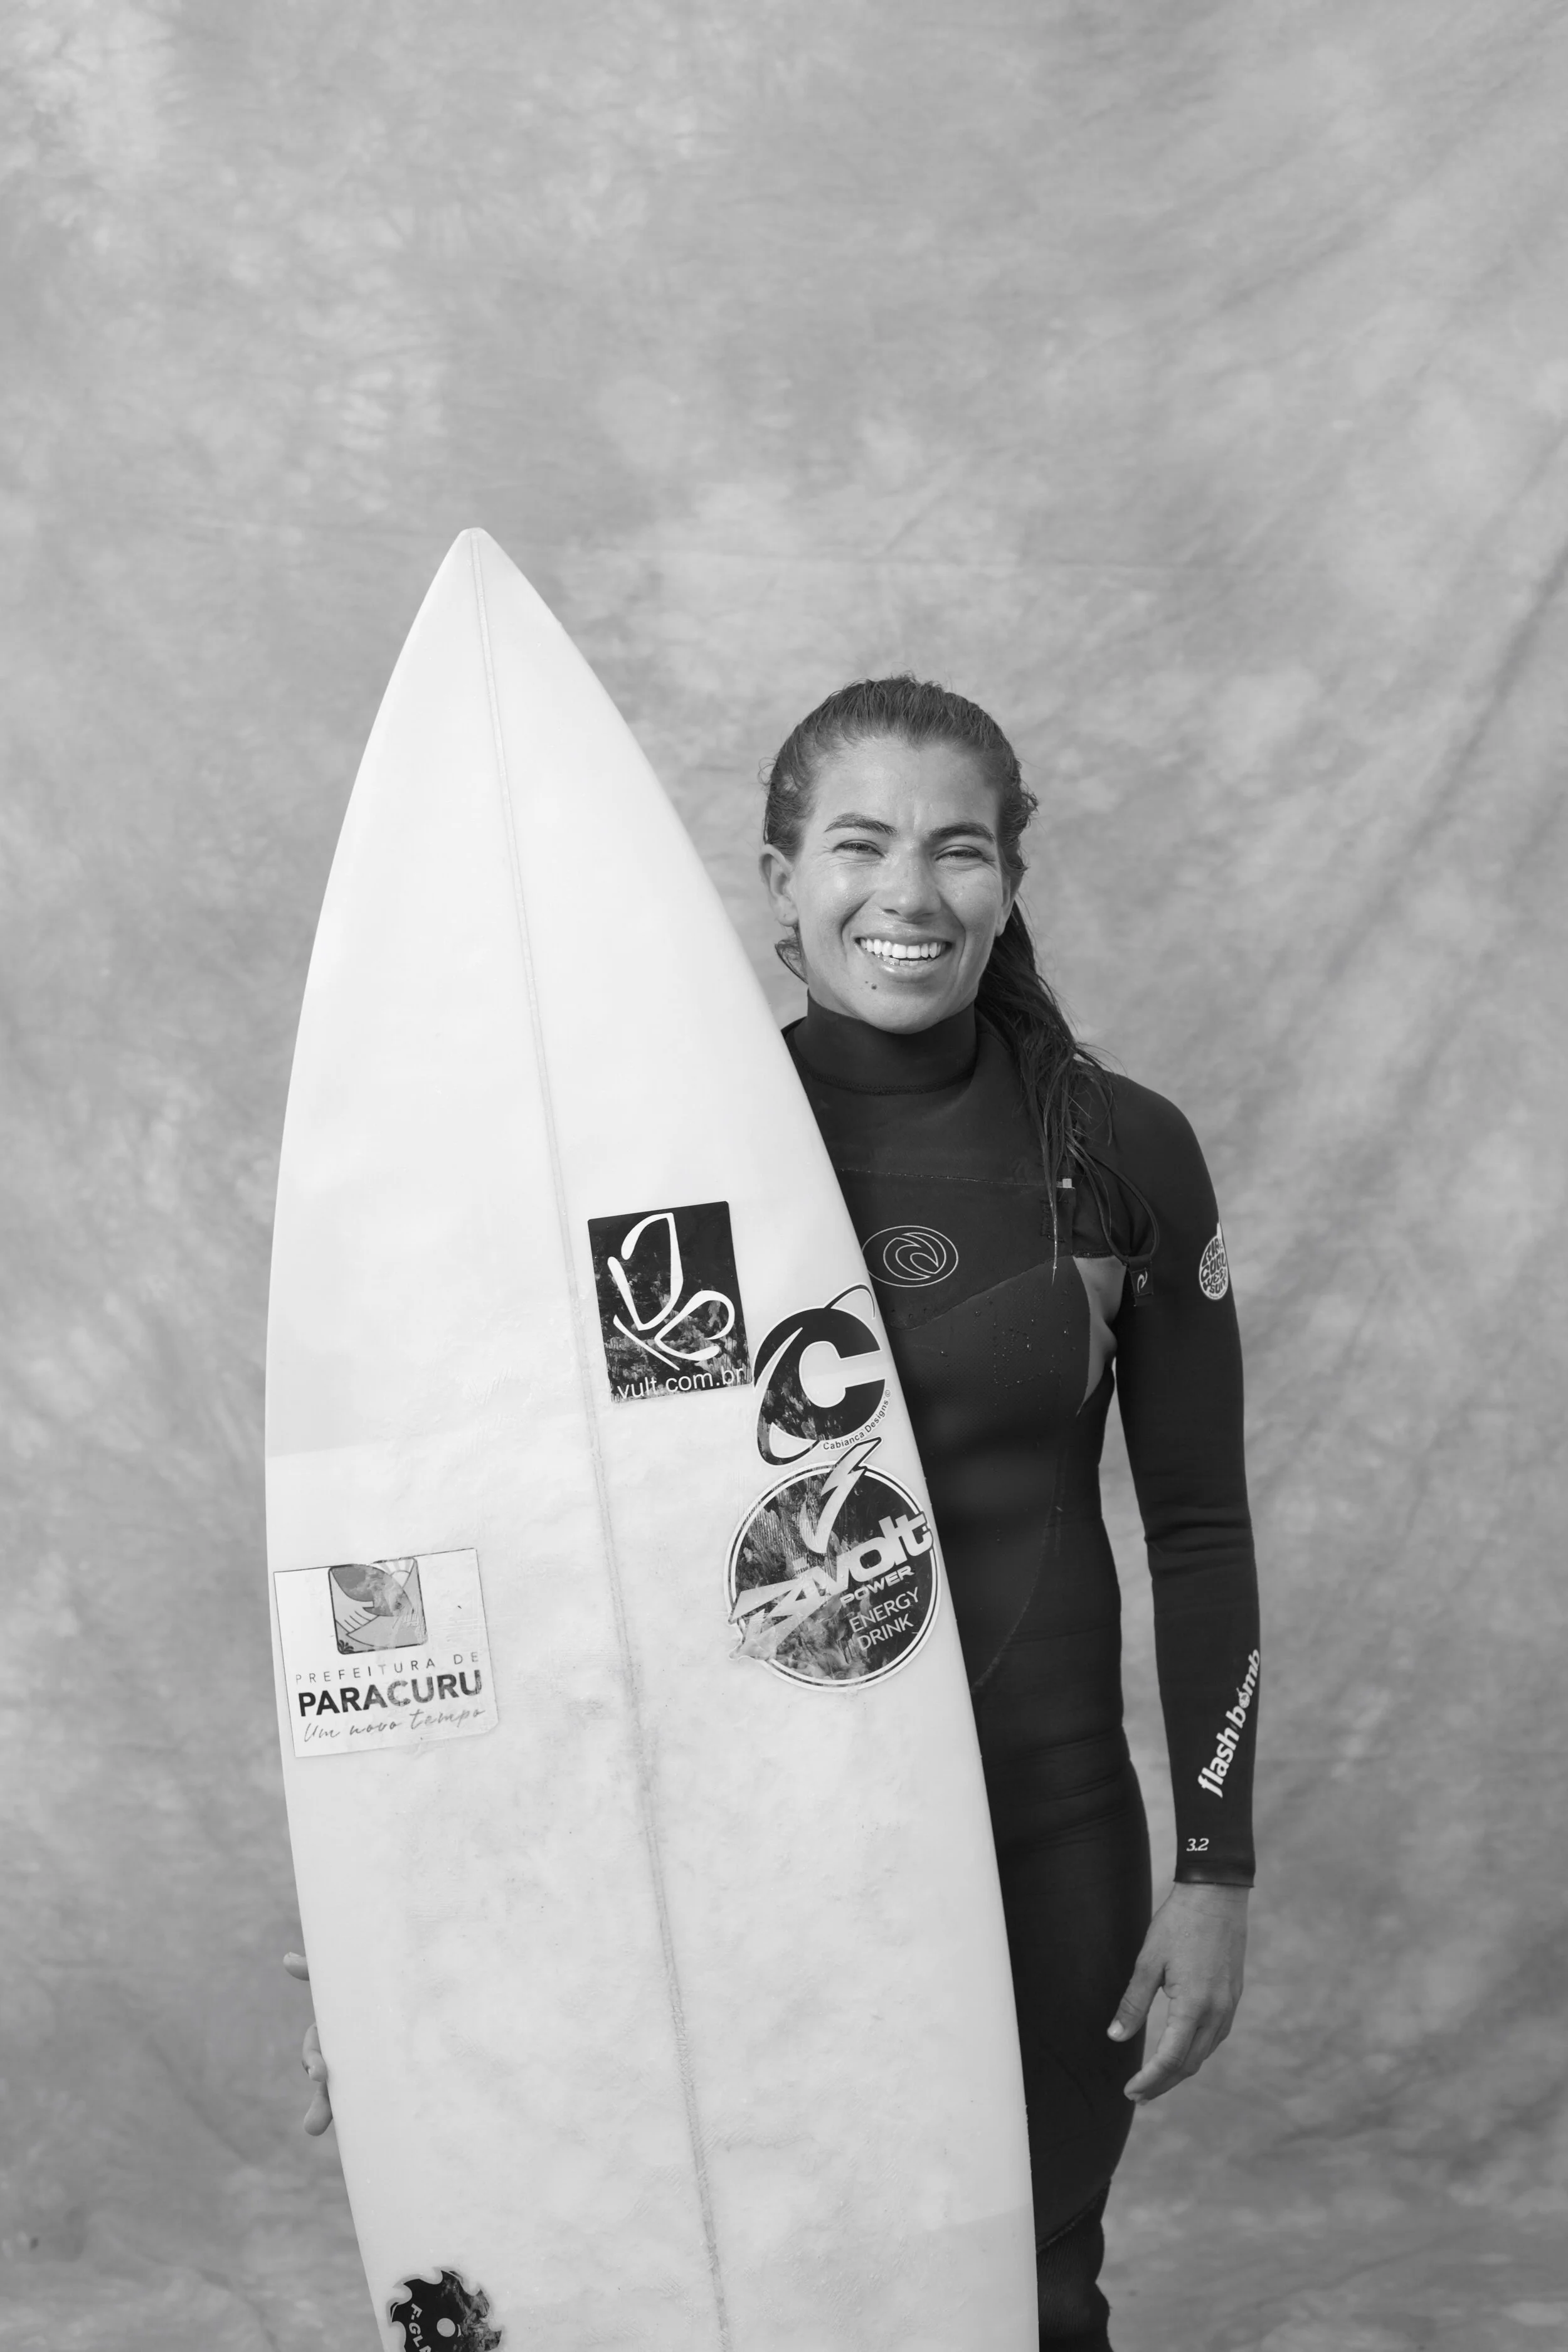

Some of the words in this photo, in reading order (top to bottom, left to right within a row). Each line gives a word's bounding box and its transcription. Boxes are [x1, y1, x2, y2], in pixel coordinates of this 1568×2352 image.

[617, 1365, 746, 1399] vultcom.br
[823, 1432, 865, 1450] Cabianca
[864, 1399, 889, 1433] Designs
[840, 1564, 915, 1608] POWER
[849, 1586, 920, 1633] ENERGY
[856, 1613, 914, 1651] DRINK
[295, 1658, 436, 1685] PREFEITURA
[453, 1651, 479, 1666] DE
[298, 1669, 482, 1717] PARACURU
[304, 1722, 341, 1742] Um
[408, 1708, 486, 1730] tempo
[1198, 1726, 1240, 1798] flash
[1186, 1838, 1209, 1851] 3.2
